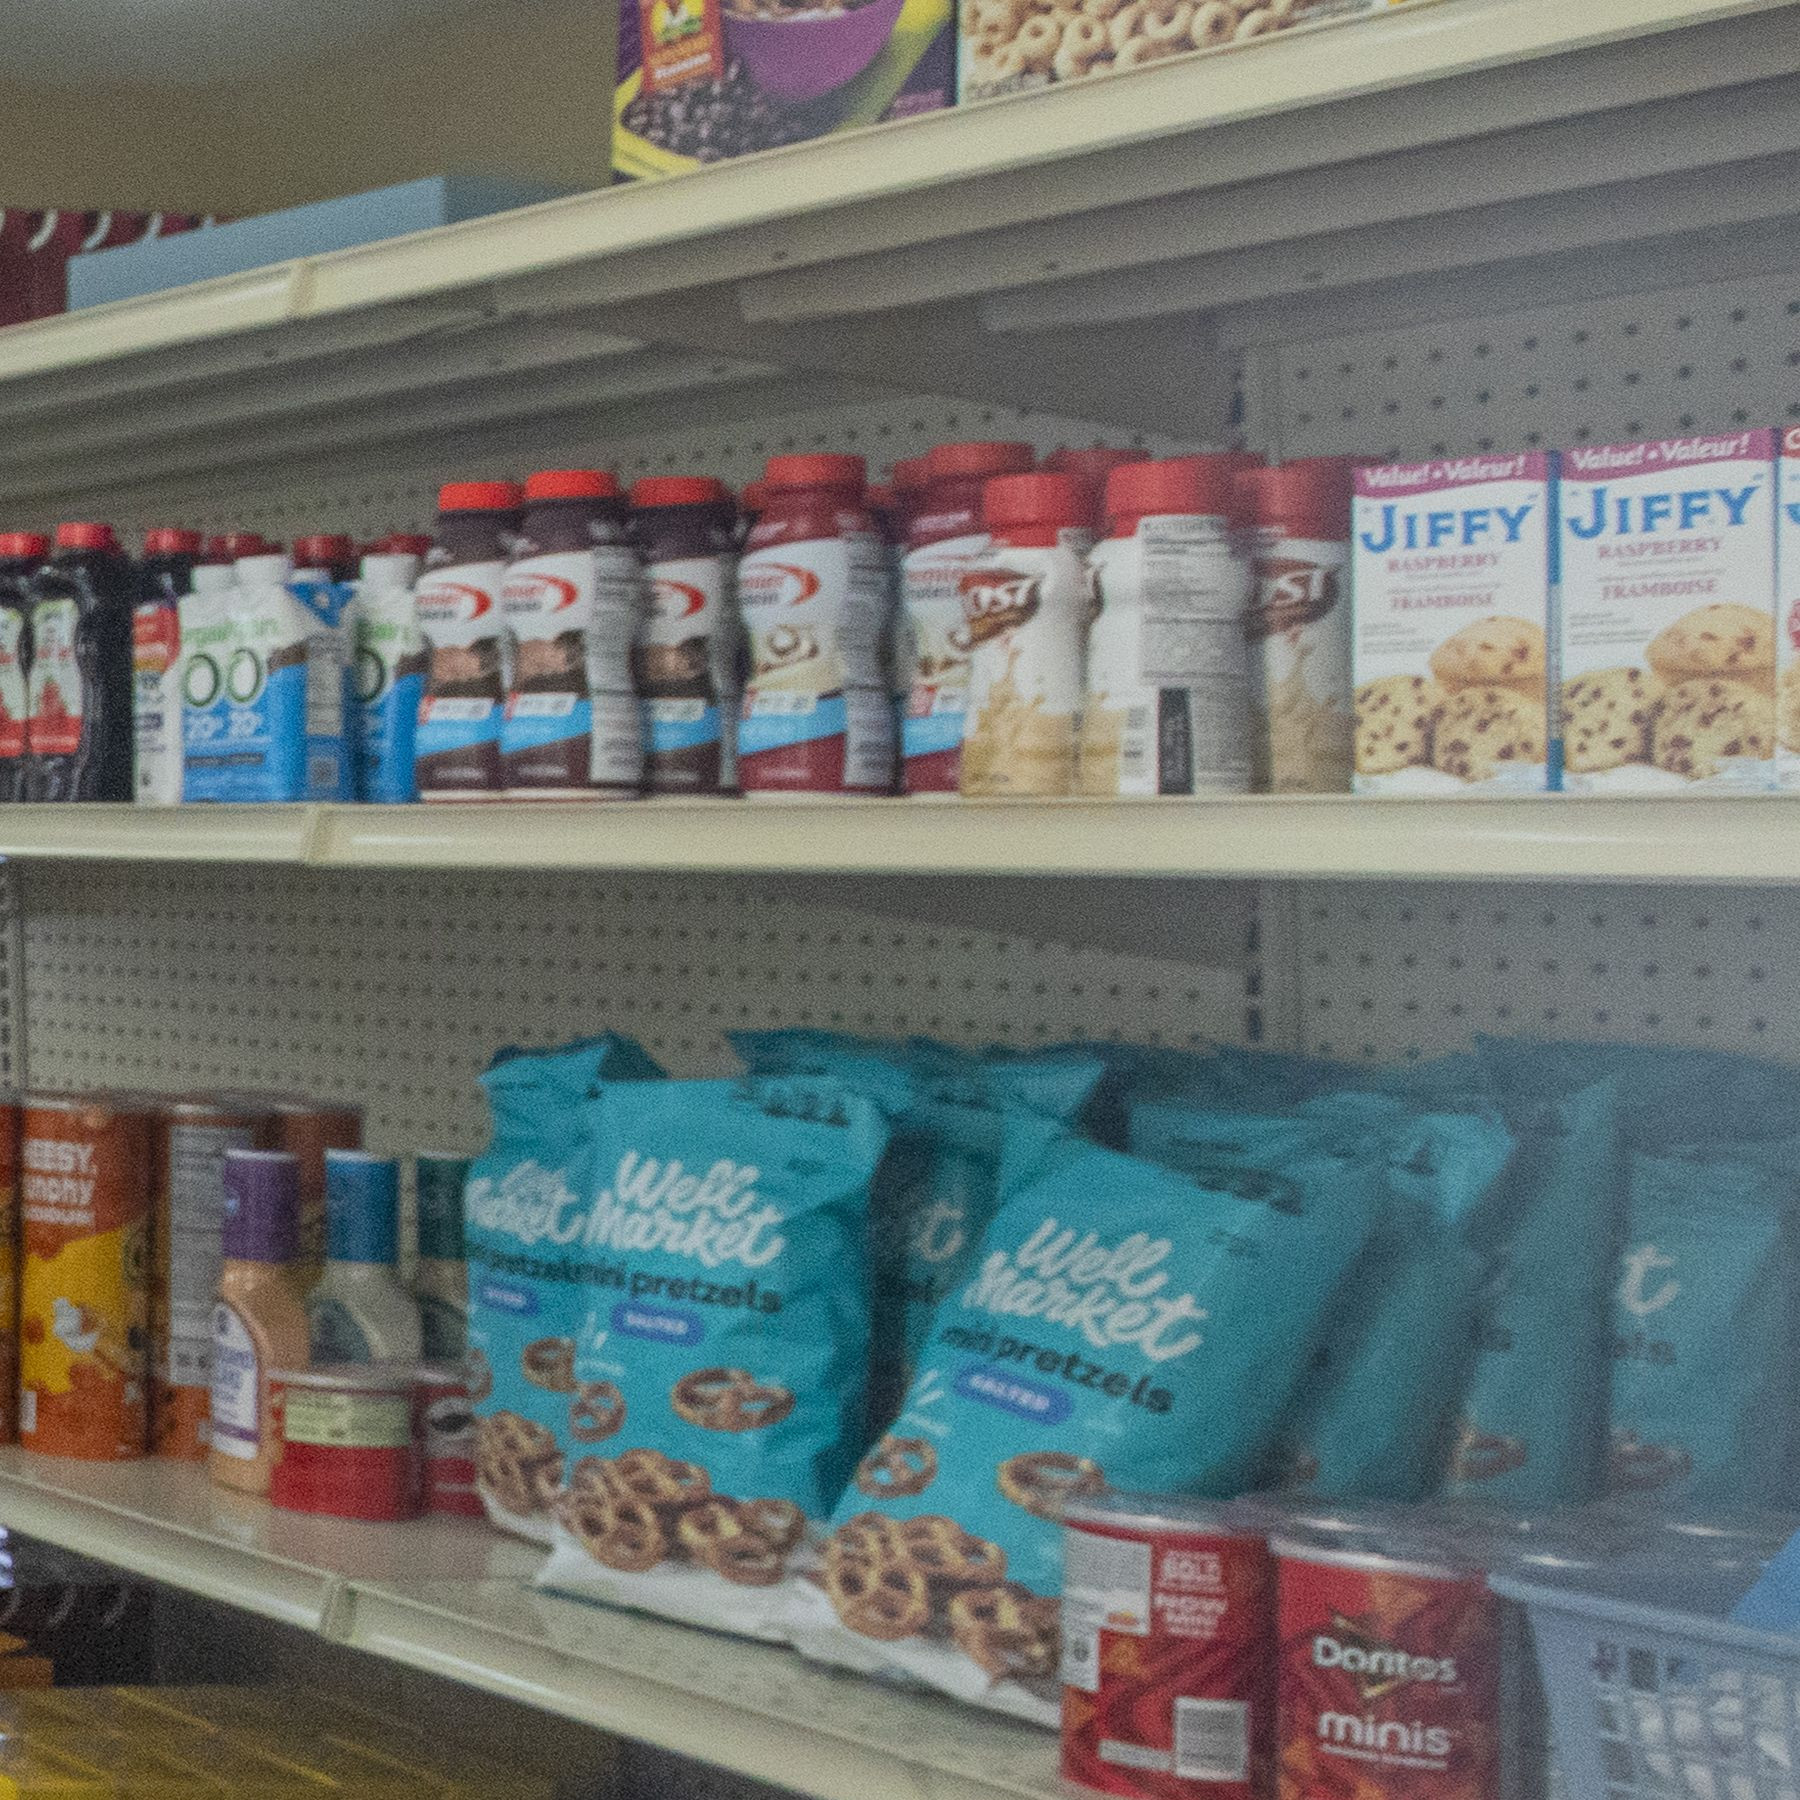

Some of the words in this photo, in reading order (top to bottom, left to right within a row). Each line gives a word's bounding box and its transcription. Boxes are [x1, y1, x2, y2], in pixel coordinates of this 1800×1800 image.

[1660, 434, 1749, 464] Valeur!
[1360, 504, 1534, 554] JIFFY
[1566, 487, 1759, 540] JIFFY
[616, 1151, 760, 1219] Well
[582, 1190, 787, 1268] Market
[1017, 1217, 1172, 1298] Well
[630, 1269, 782, 1314] pretzels
[962, 1250, 1208, 1362] Market
[993, 1333, 1175, 1414] pretzels
[1311, 1634, 1457, 1683] Doritos
[1317, 1708, 1452, 1756] minis
